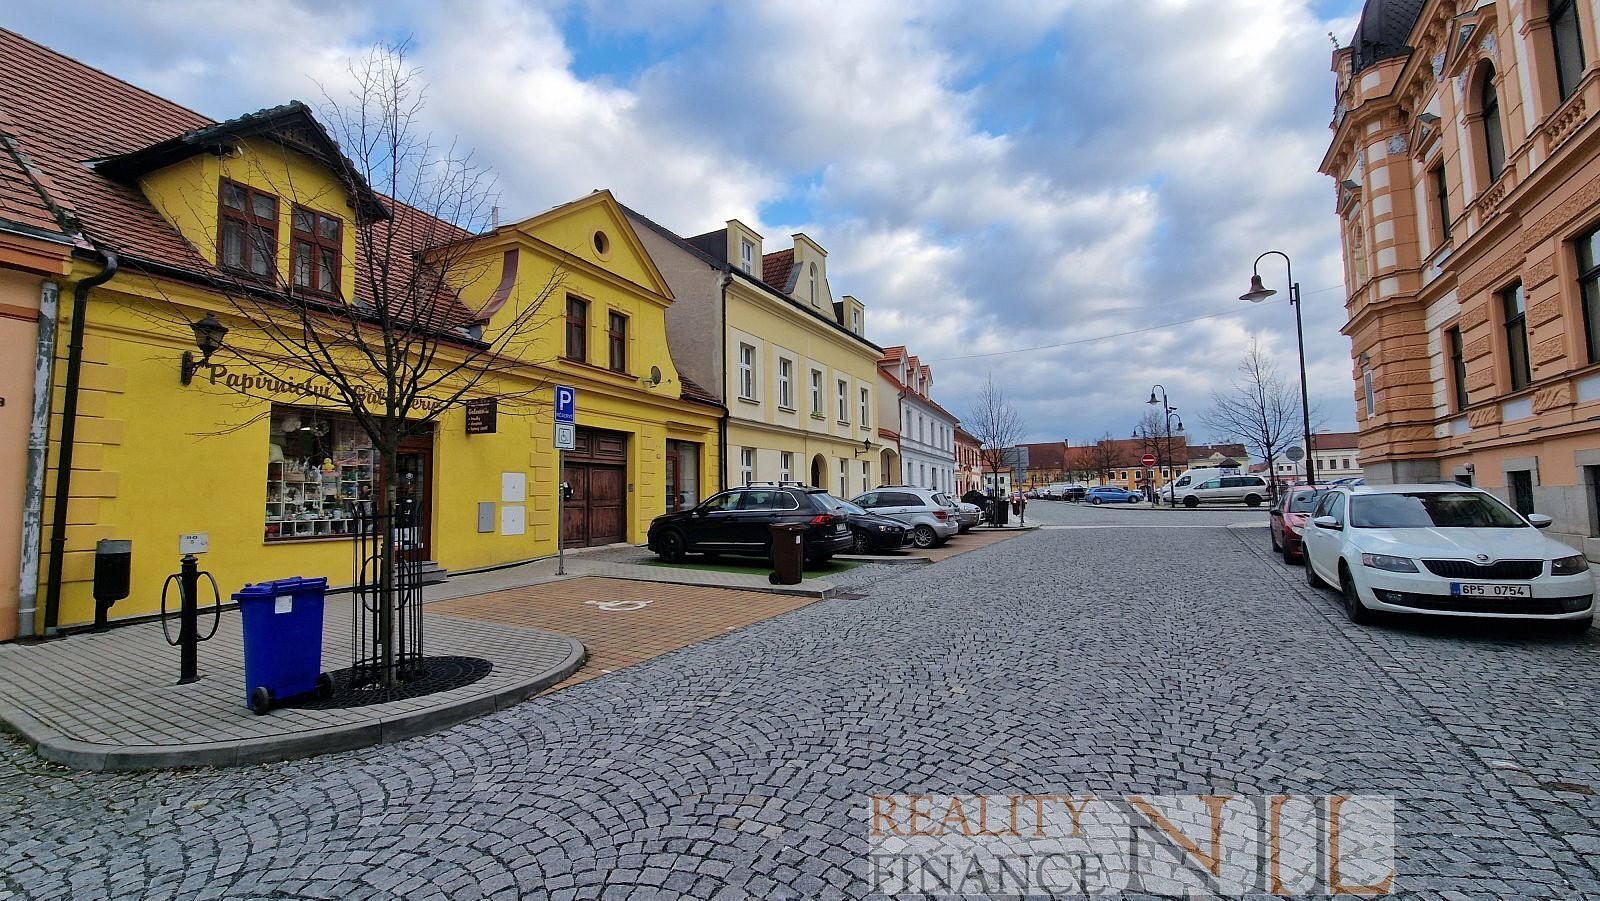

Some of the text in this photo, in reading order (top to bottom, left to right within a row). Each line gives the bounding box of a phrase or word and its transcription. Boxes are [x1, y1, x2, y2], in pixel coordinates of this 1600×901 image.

[560, 390, 571, 411] P
[1462, 585, 1524, 595] 6P5 0754
